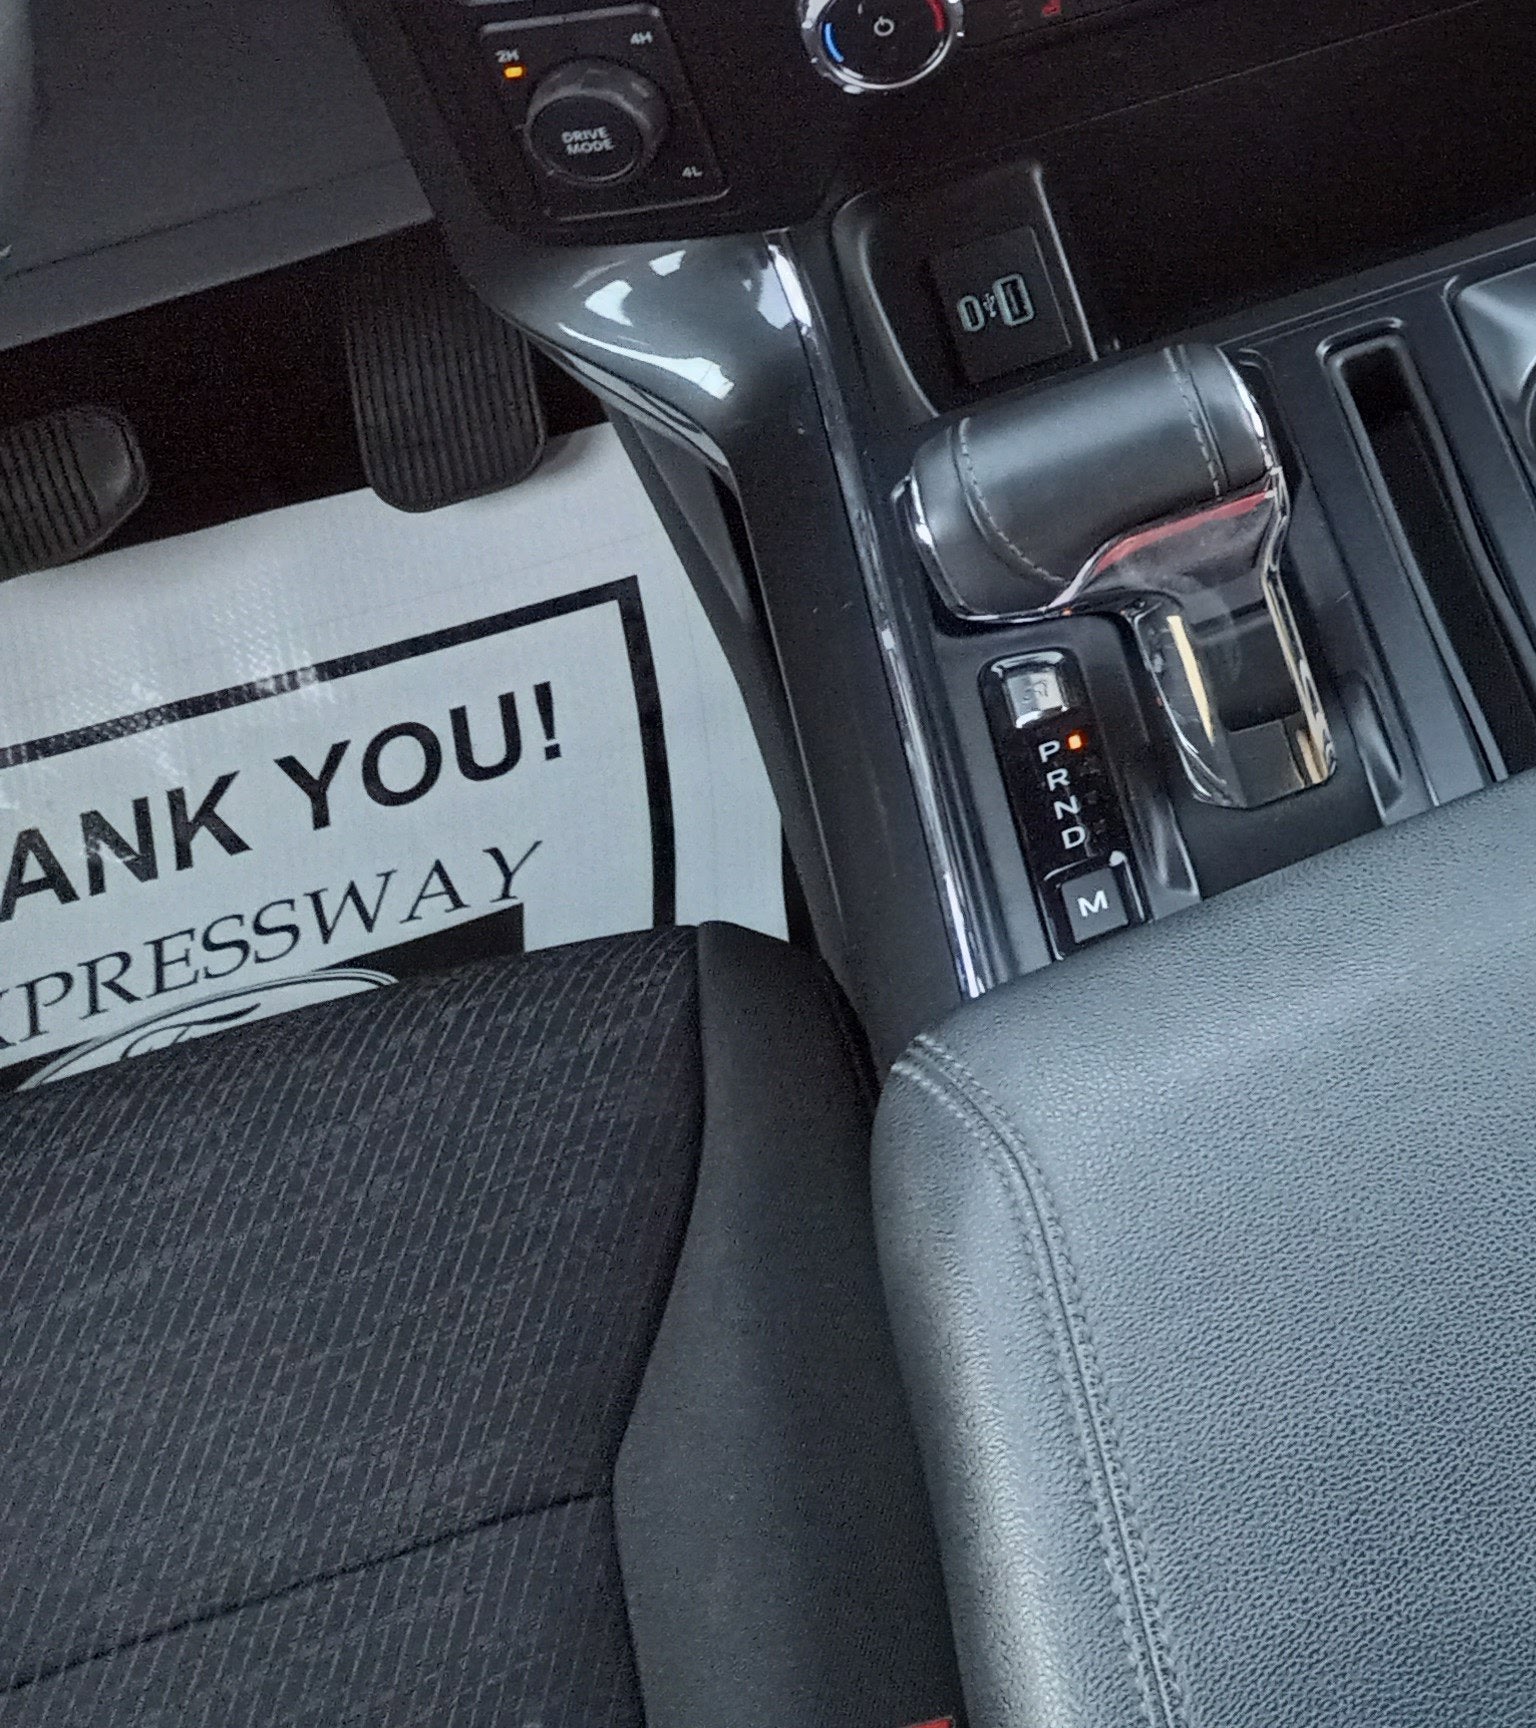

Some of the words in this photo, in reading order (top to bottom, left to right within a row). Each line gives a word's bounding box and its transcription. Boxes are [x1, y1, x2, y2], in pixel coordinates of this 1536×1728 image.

[561, 126, 609, 145] DRIVE
[566, 137, 614, 156] MODE
[273, 681, 562, 831] YOU!
[1038, 740, 1061, 763] P
[1046, 768, 1070, 791] R
[1053, 795, 1081, 820] N
[1061, 826, 1086, 850] D
[1076, 890, 1109, 918] M
